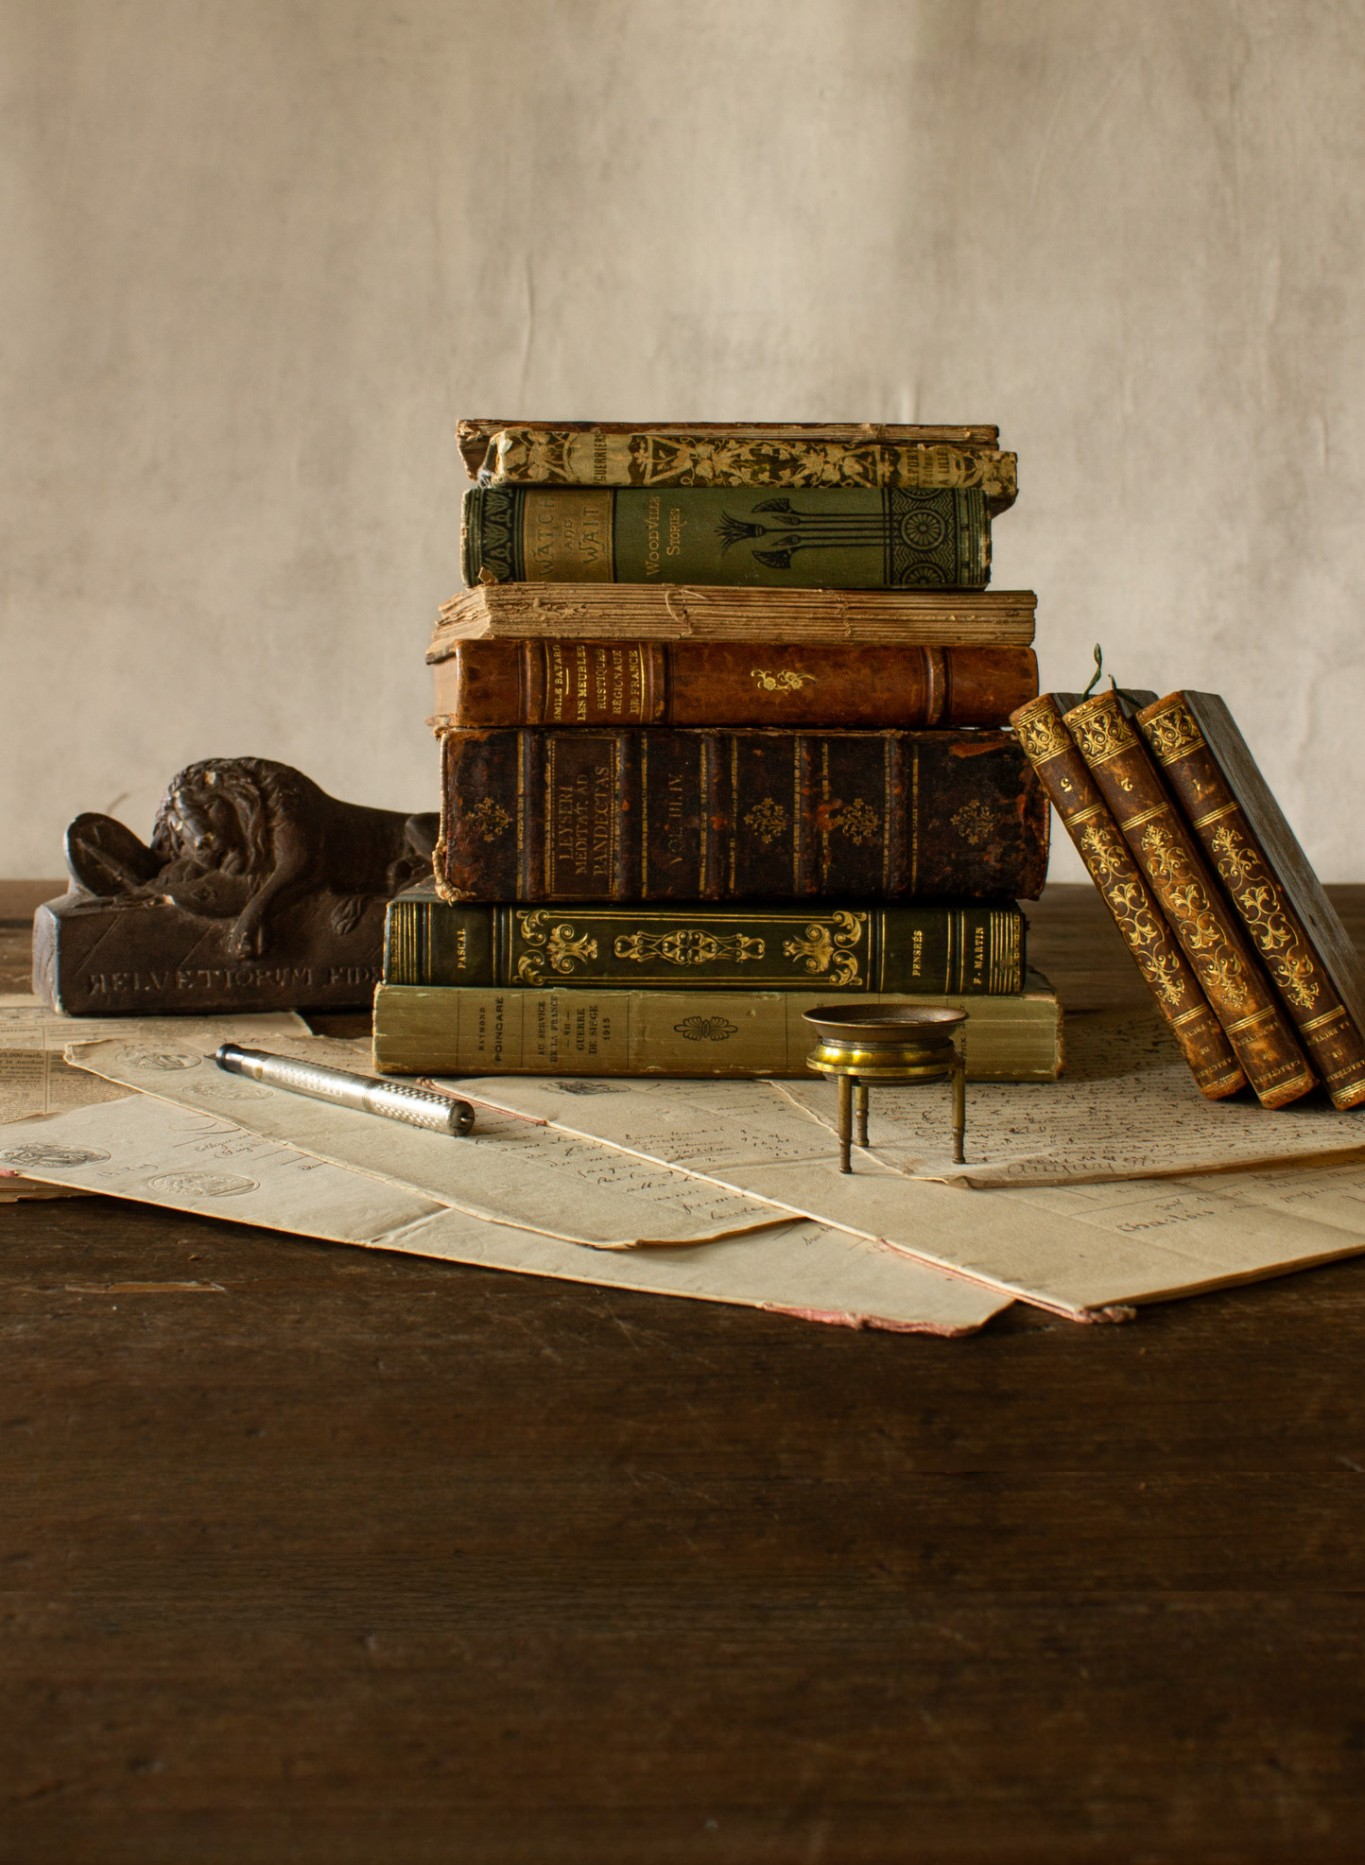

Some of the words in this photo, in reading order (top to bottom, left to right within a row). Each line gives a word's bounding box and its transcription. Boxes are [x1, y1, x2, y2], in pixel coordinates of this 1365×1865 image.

[531, 497, 555, 576] WATCH
[563, 520, 574, 551] AND
[578, 507, 605, 564] WAIT
[576, 645, 588, 697] MEUBLES
[628, 650, 640, 695] FRANCE
[577, 700, 587, 721] LES
[1120, 777, 1133, 792] 2
[457, 928, 466, 969] PASCAL
[974, 927, 984, 970] MARTIN
[478, 1007, 486, 1051] RAYMOND
[494, 996, 504, 1062] POINCARÉ
[538, 1000, 546, 1040] SERVICE
[550, 995, 558, 1032] FRANCE
[576, 1008, 586, 1052] GUERRE
[538, 1043, 546, 1056] AU
[550, 1035, 558, 1047] LA
[550, 1050, 558, 1063] DE
[588, 1040, 598, 1055] DE
